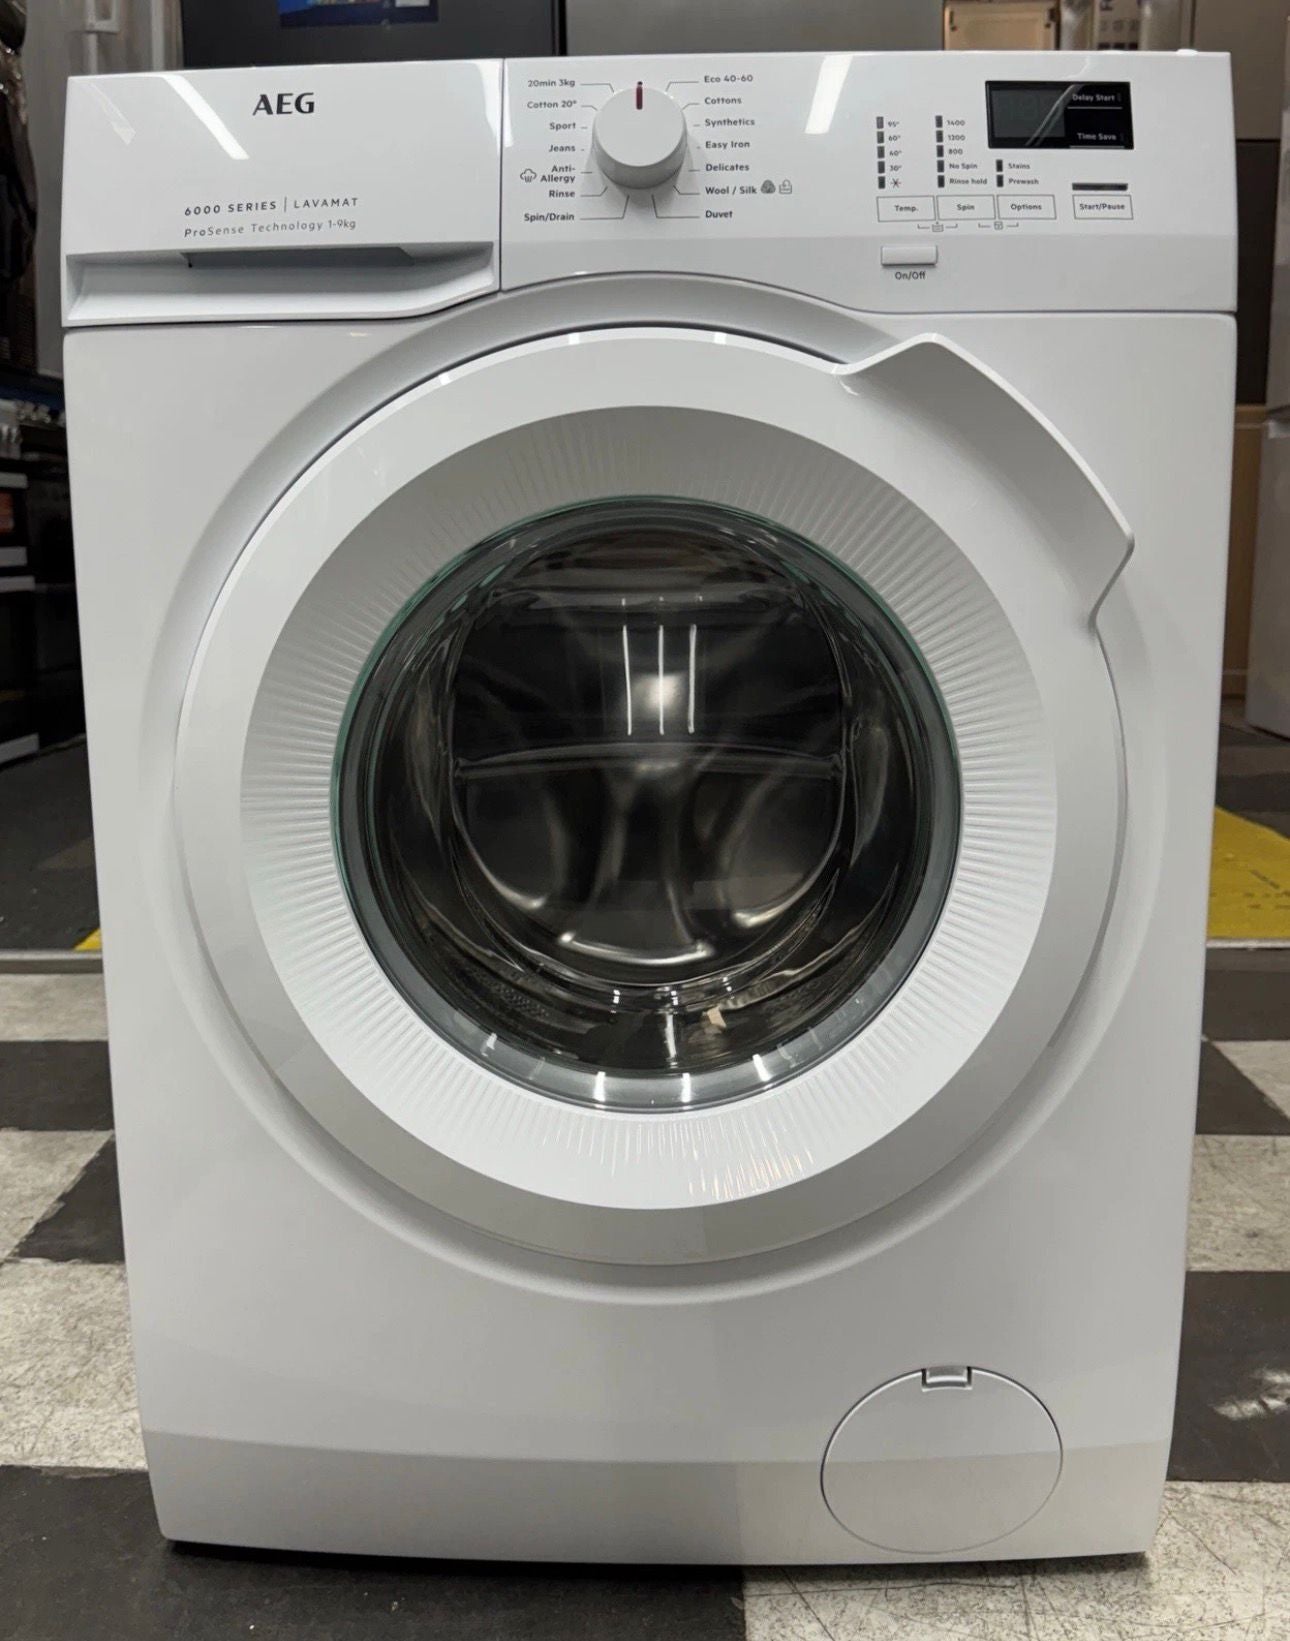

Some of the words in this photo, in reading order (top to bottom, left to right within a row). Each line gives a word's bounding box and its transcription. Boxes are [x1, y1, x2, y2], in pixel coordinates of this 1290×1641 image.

[527, 79, 557, 88] 20min
[559, 78, 576, 88] 3kg
[704, 75, 721, 83] Eco
[723, 74, 754, 82] 40-60
[704, 96, 743, 105] Cottons
[1072, 93, 1094, 102] Delay
[1095, 93, 1115, 101] Start
[252, 92, 315, 116] AEG
[527, 101, 559, 109] Cotton
[561, 99, 577, 108] 20°
[549, 121, 576, 131] Sport
[704, 118, 756, 128] Synthetics
[947, 119, 966, 127] 1400
[1077, 132, 1096, 140] Time
[1098, 132, 1117, 140] Save
[548, 144, 576, 153] Jeans
[705, 140, 728, 149] Easy
[731, 140, 751, 148] Iron
[551, 164, 576, 173] Anti-
[705, 163, 751, 172] Delicates
[961, 162, 978, 170] Spin
[1008, 162, 1031, 170] Stains
[540, 174, 576, 184] Allergy
[971, 177, 988, 185] hold
[1008, 177, 1039, 185] Prewash
[548, 189, 576, 198] Rinse
[705, 186, 730, 195] Wool
[739, 186, 757, 195] Silk
[184, 204, 221, 217] 6000
[227, 200, 277, 213] SERIES
[293, 197, 358, 209] LAVAMAT
[894, 204, 919, 212] Temp.
[956, 203, 976, 211] Spin
[1010, 203, 1042, 211] Options
[1079, 203, 1125, 211] Start/Pause
[524, 212, 575, 223] Spin/Drain
[705, 209, 733, 219] Duvet
[184, 225, 245, 238] ProSense
[251, 220, 323, 232] Technology
[327, 218, 357, 230] 1-9kg
[894, 271, 926, 280] On/Off
